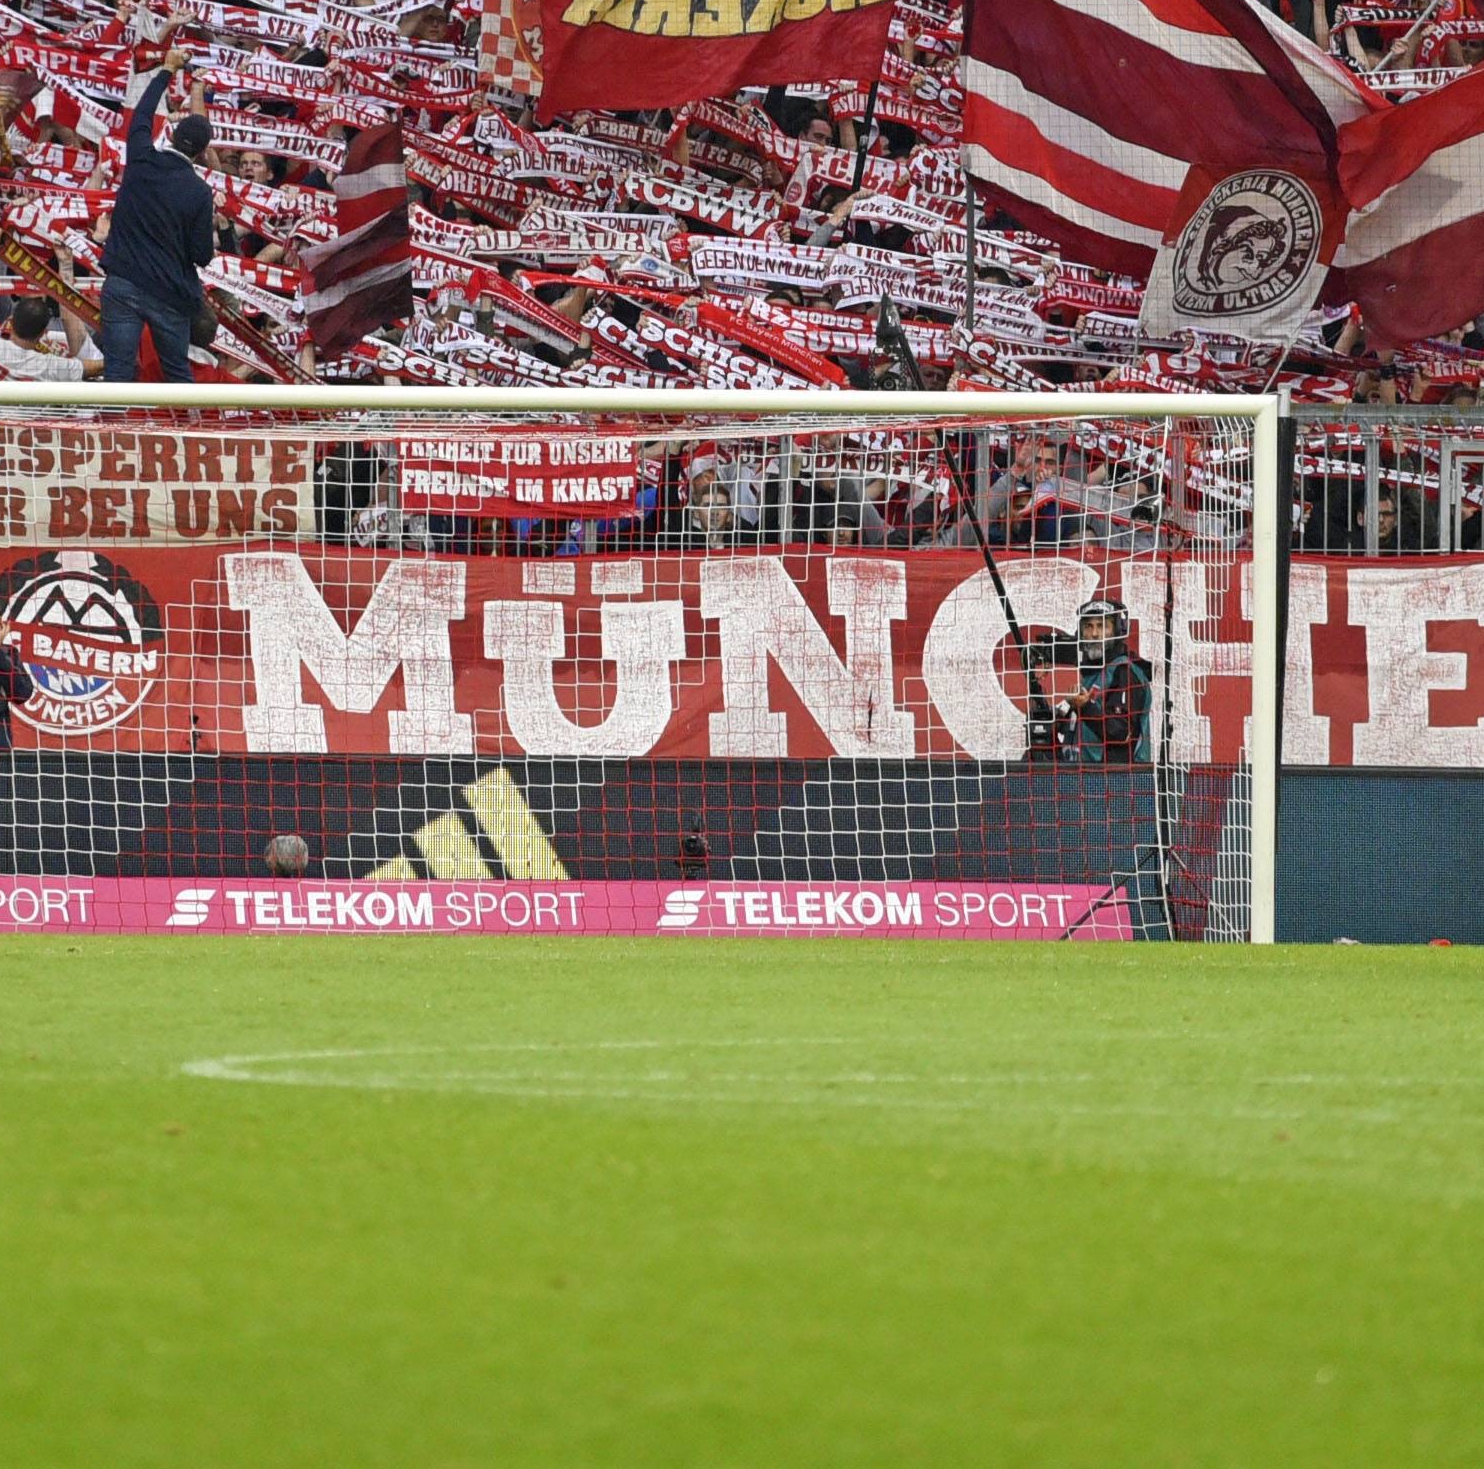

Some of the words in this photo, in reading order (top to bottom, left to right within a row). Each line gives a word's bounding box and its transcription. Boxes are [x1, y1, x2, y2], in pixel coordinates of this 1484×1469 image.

[1223, 269, 1294, 309] ULTRAS
[549, 438, 632, 465] UNSERE
[400, 470, 508, 499] FREUNDE
[515, 477, 546, 502] IM
[551, 476, 635, 503] KNAST
[49, 486, 156, 538] BEI
[170, 489, 299, 540] UNS
[32, 632, 158, 675] BAYERN
[24, 689, 128, 727] ÜNCHEN
[225, 890, 434, 927] TELEKOM
[445, 891, 586, 927] SPORT
[715, 891, 923, 927] TELEKOM
[934, 893, 1073, 929] SPORT
